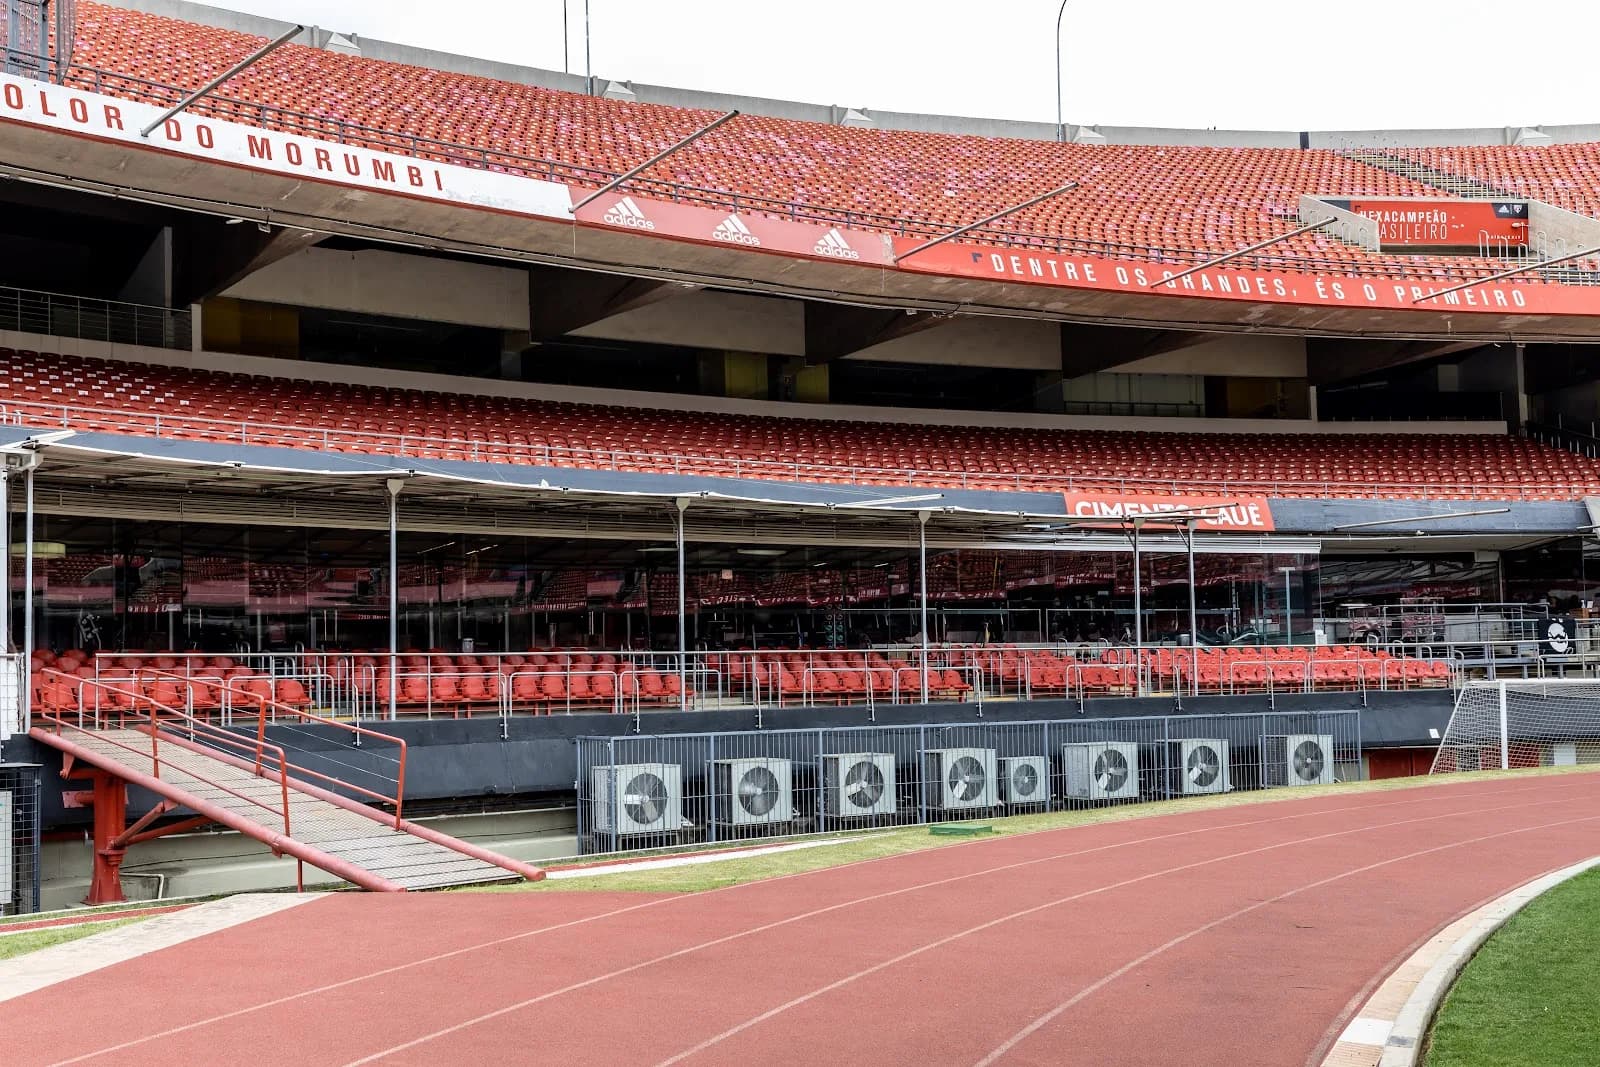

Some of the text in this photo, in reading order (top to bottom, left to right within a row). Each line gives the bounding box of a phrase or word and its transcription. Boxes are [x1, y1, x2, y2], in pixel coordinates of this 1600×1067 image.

[4, 83, 443, 191] OLOR DO MORUMBI
[604, 212, 655, 230] adidas
[712, 229, 761, 247] adidas
[1380, 224, 1447, 240] ASILEIRO
[814, 243, 859, 260] adidas
[990, 253, 1526, 307] DENTRE OS GRANDES, ÉS O PRIMEIRO
